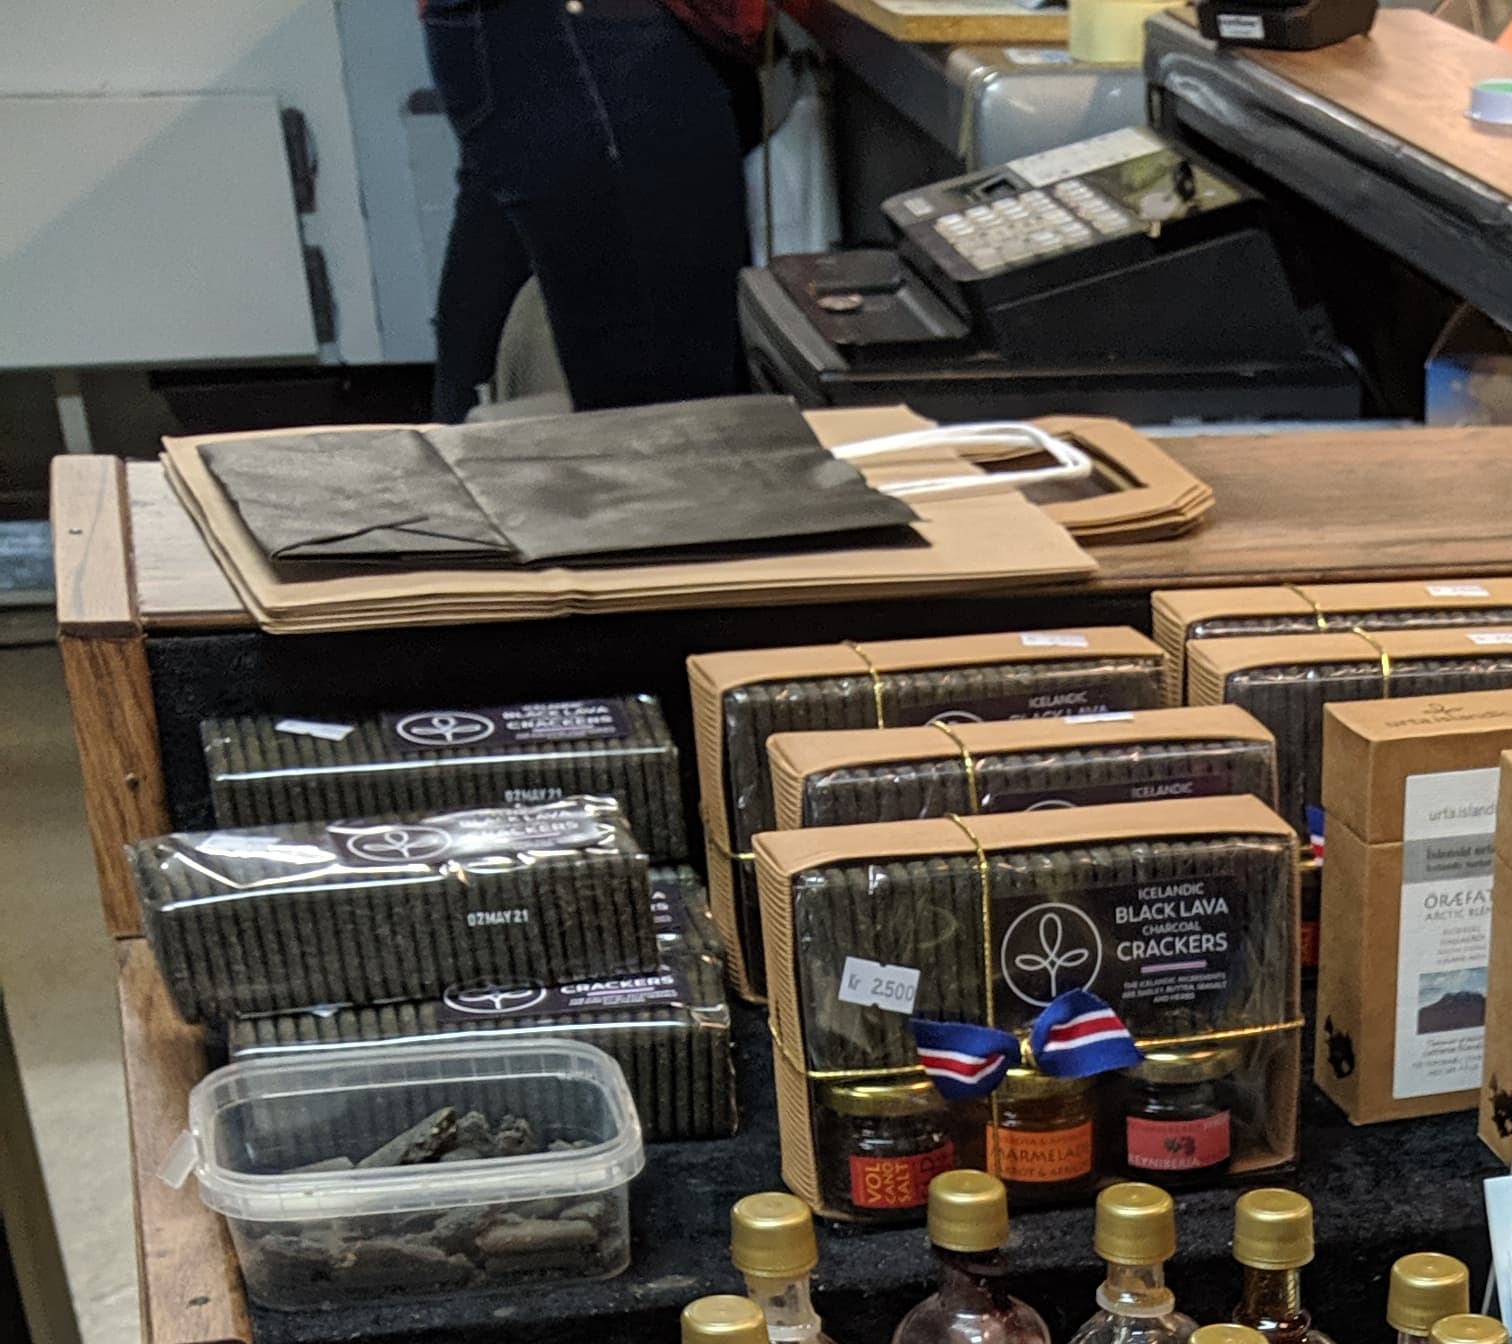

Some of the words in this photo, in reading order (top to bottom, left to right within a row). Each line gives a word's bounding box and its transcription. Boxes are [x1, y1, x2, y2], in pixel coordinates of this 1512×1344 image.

[1131, 782, 1193, 798] ICELANDIC
[1138, 882, 1204, 900] ICELANDIC
[1115, 902, 1176, 924] BLACK
[1180, 898, 1229, 917] LAVA
[1425, 908, 1464, 920] ARCTIC
[1142, 921, 1201, 936] CHARCOAL
[1117, 933, 1228, 961] CRACKERS
[561, 976, 674, 994] CRACKERS
[865, 1162, 882, 1203] VOL
[897, 1163, 911, 1202] SALT
